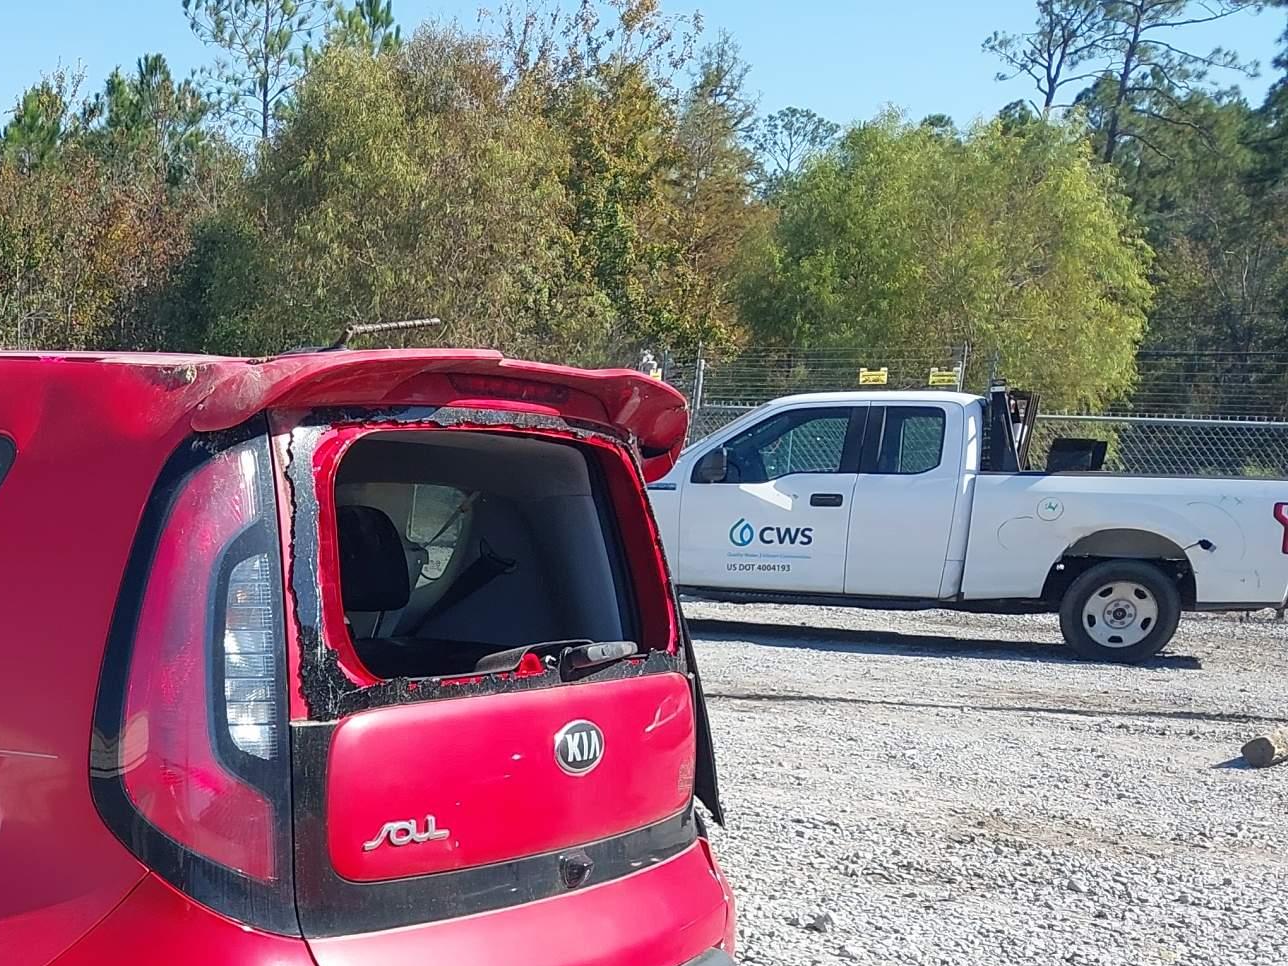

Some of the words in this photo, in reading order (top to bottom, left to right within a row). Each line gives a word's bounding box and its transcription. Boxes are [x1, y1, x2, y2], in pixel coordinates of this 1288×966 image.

[758, 526, 814, 546] CWS
[726, 563, 738, 572] US
[739, 563, 756, 572] DOT
[757, 564, 791, 572] 4004193
[565, 730, 600, 763] KIA
[363, 814, 450, 851] SOUL
